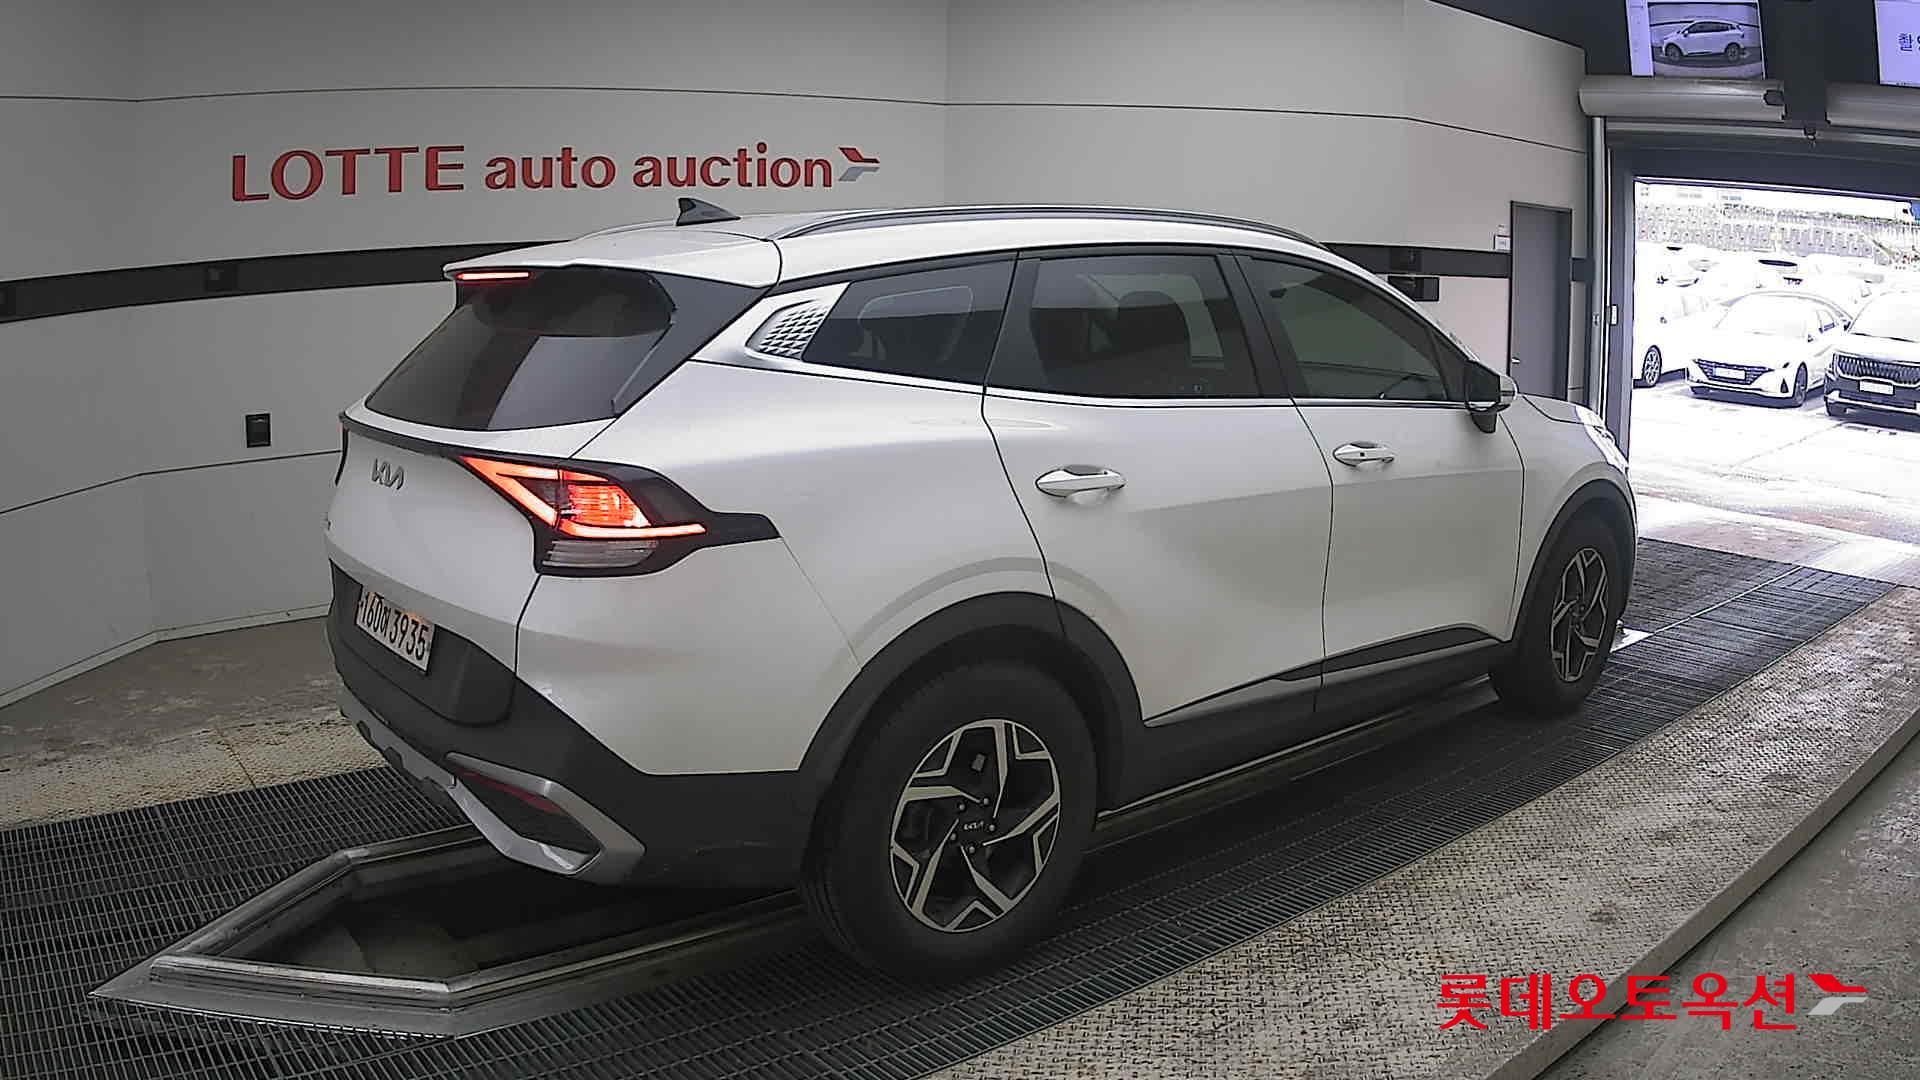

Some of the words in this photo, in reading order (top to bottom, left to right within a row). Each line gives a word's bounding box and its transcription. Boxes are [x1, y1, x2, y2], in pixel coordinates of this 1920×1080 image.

[233, 146, 465, 201] LOTTE
[485, 147, 617, 191] auto
[633, 143, 833, 189] auction
